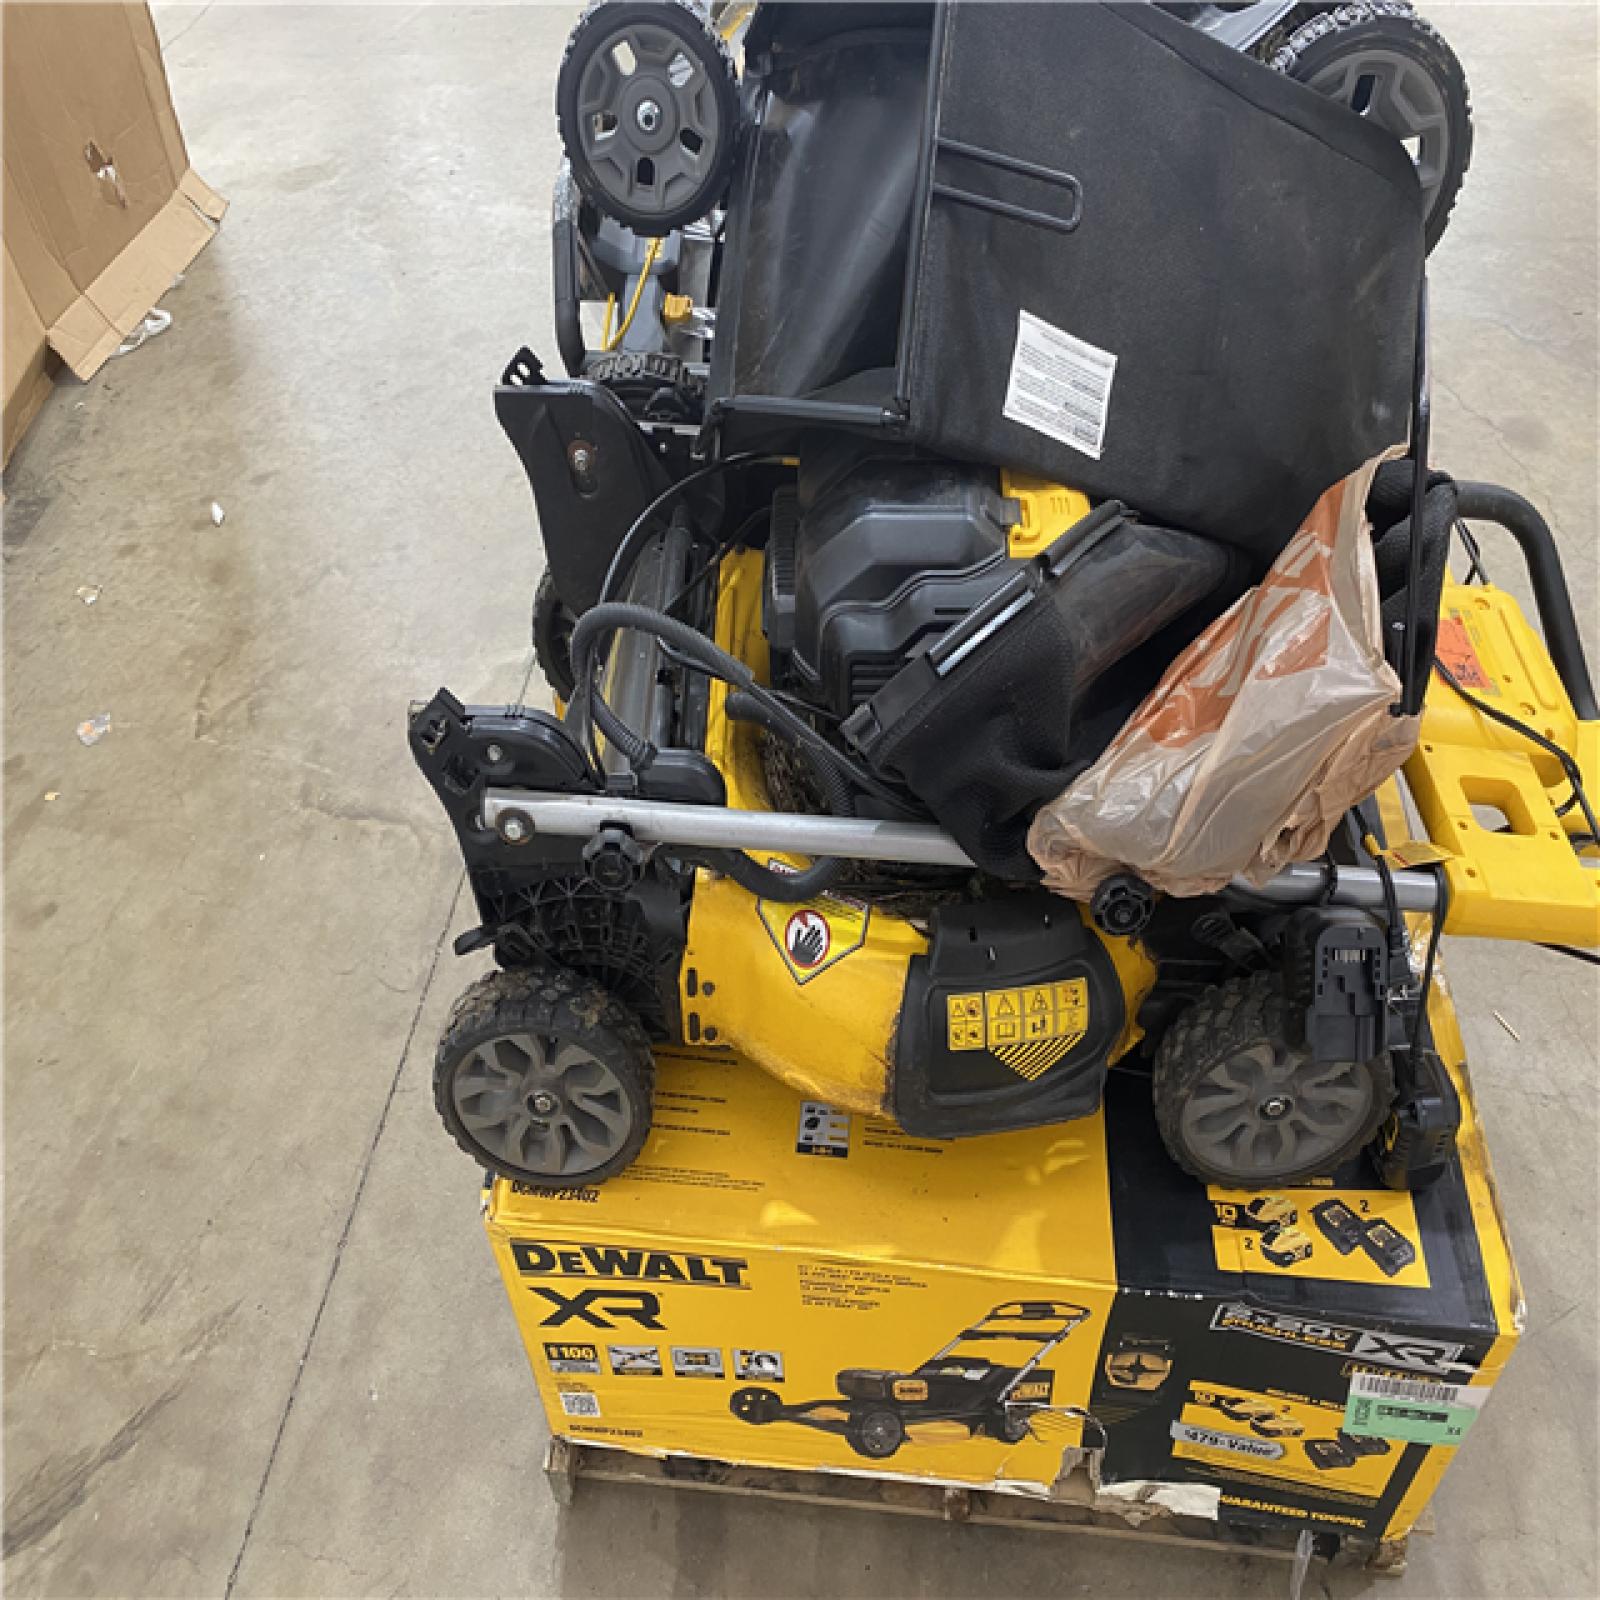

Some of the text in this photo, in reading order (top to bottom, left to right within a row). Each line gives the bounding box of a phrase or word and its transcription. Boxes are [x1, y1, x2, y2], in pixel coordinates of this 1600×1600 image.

[511, 1244, 748, 1284] DEWALT
[528, 1287, 667, 1330] XR
[1356, 1335, 1448, 1366] XR
